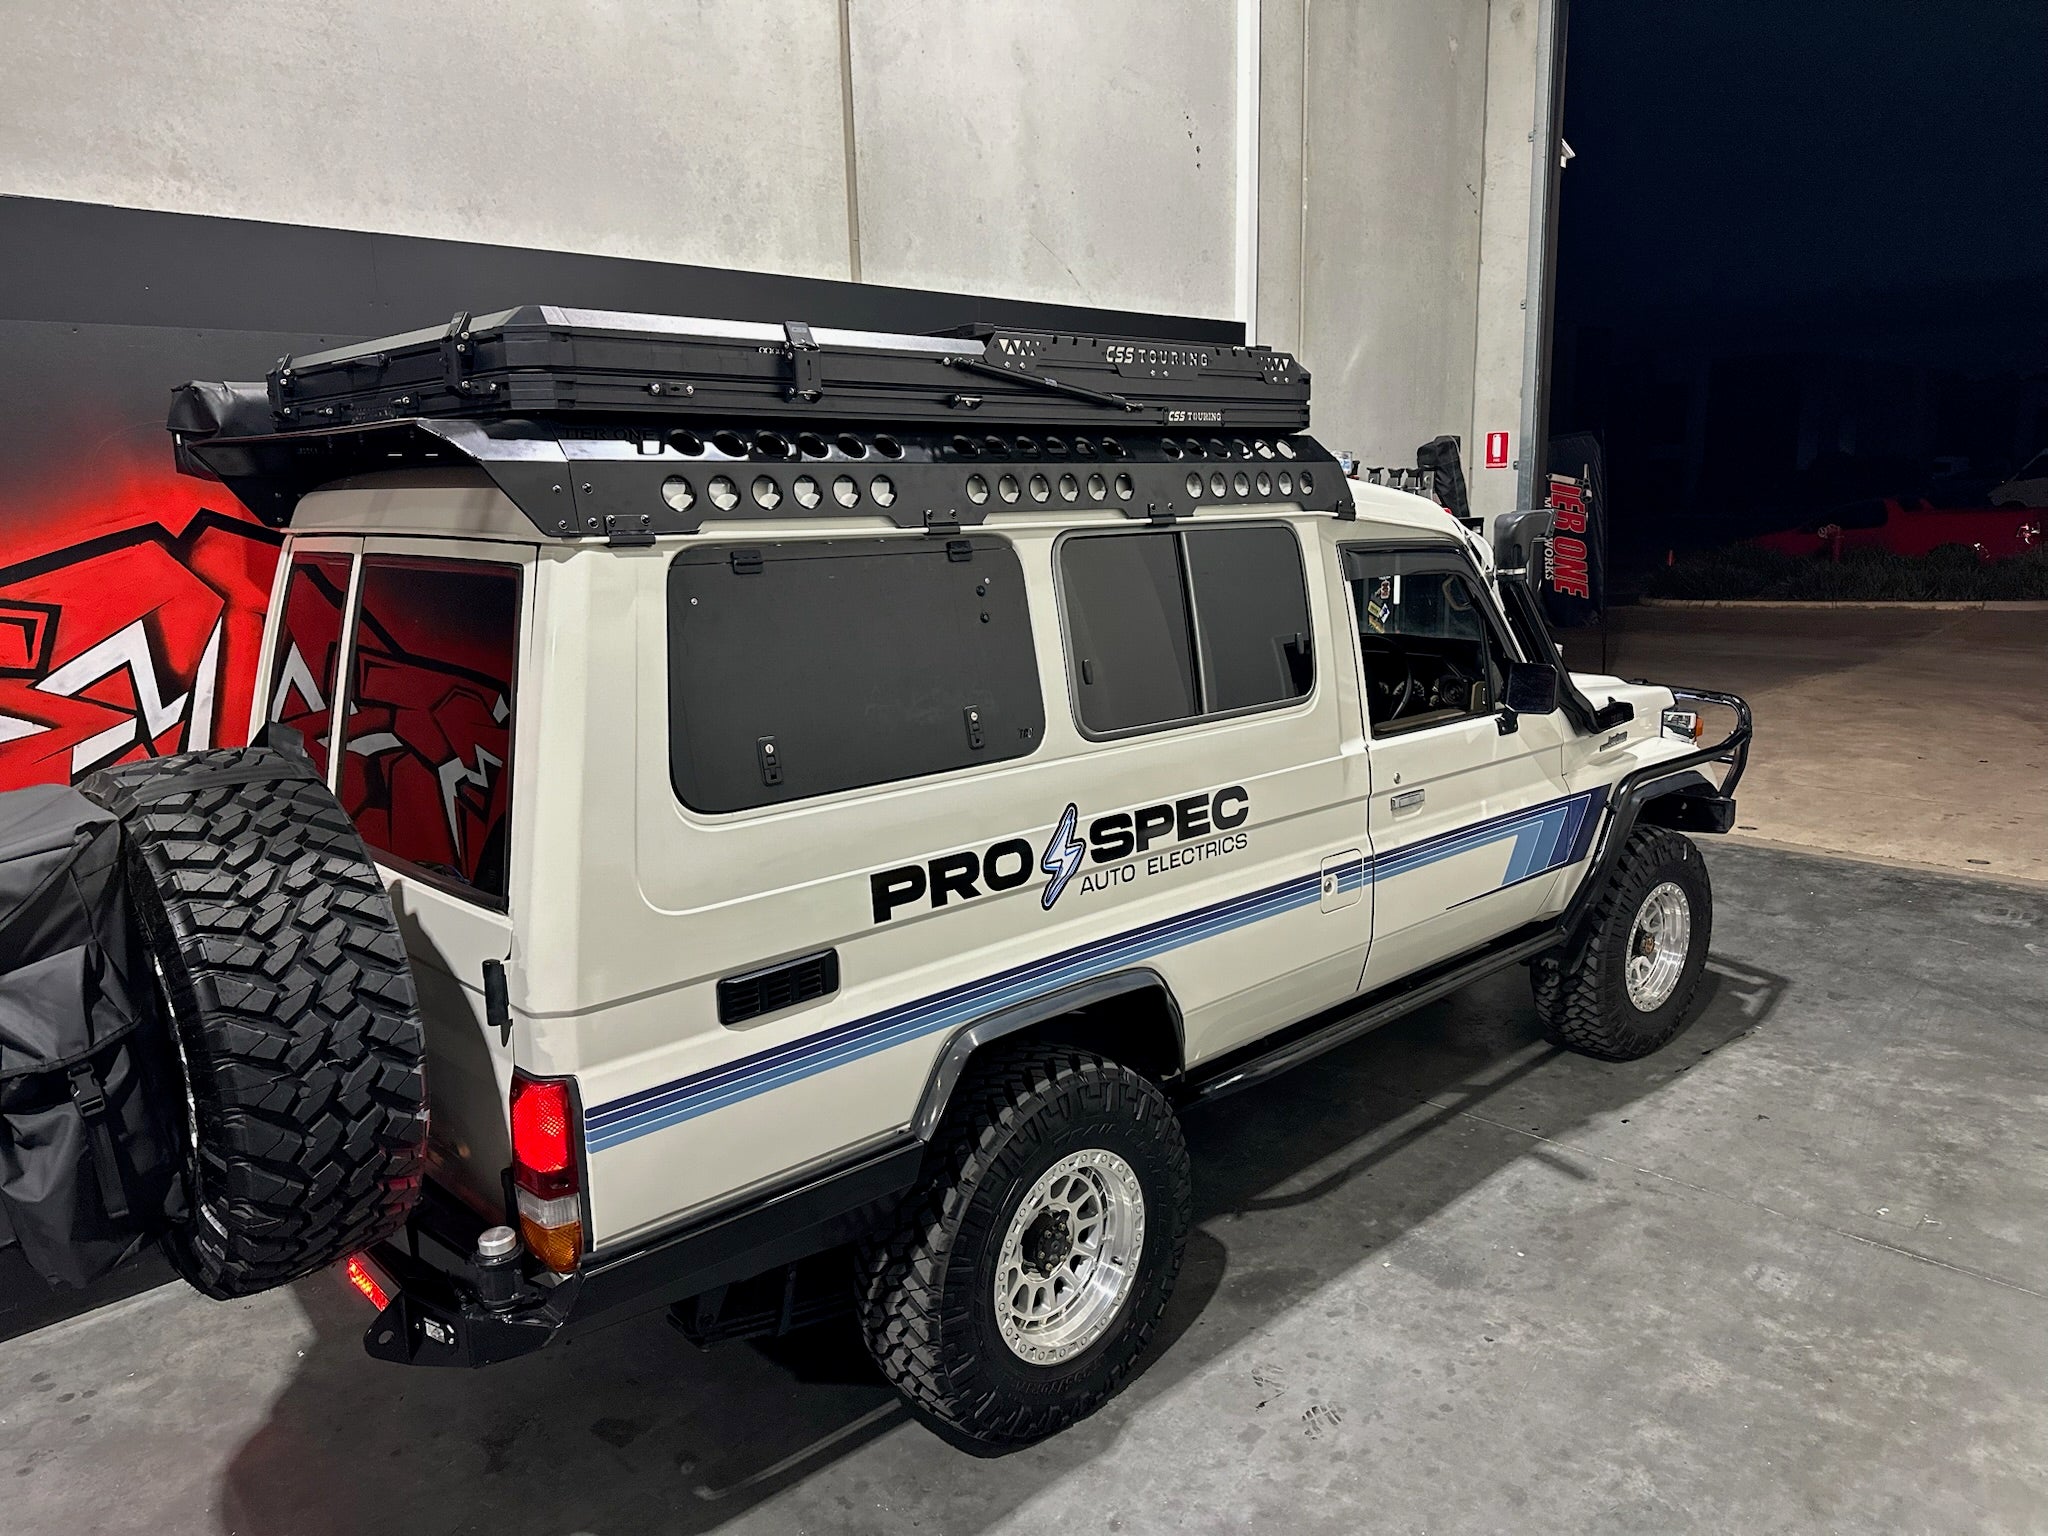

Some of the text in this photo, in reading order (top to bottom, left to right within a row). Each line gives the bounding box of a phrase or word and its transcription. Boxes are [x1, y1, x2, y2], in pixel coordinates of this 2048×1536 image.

[1105, 345, 1209, 367] CSS TOURING
[1168, 410, 1222, 422] CSS TOURING
[1543, 537, 1554, 581] WORKS
[1553, 535, 1590, 599] ONE
[869, 785, 1249, 925] PRO SPEC
[1079, 832, 1249, 896] AUTO ELECTRICS
